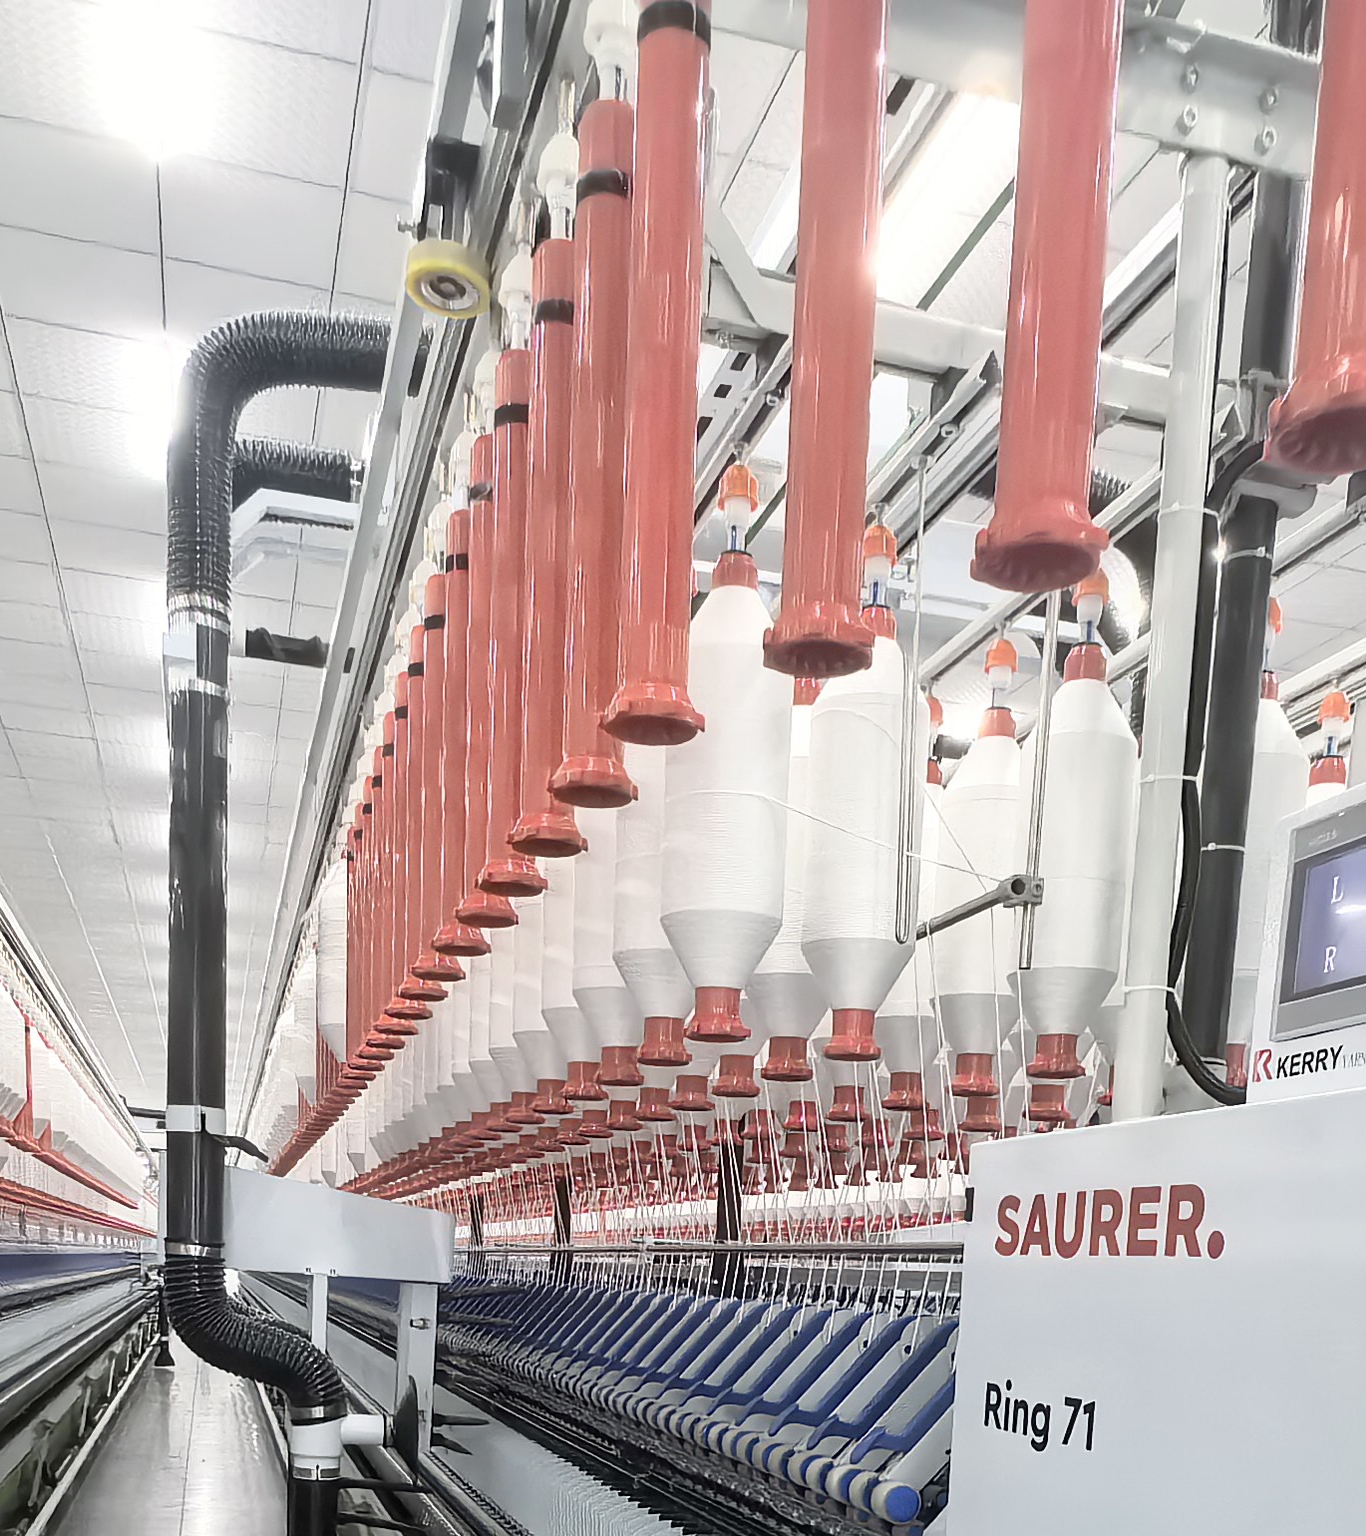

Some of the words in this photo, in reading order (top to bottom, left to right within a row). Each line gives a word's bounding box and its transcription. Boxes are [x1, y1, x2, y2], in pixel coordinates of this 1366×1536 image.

[1331, 876, 1344, 904] L
[1323, 945, 1336, 973] R
[1276, 1044, 1343, 1079] KERRY
[983, 1378, 1052, 1452] Ring
[1061, 1395, 1097, 1452] 71
